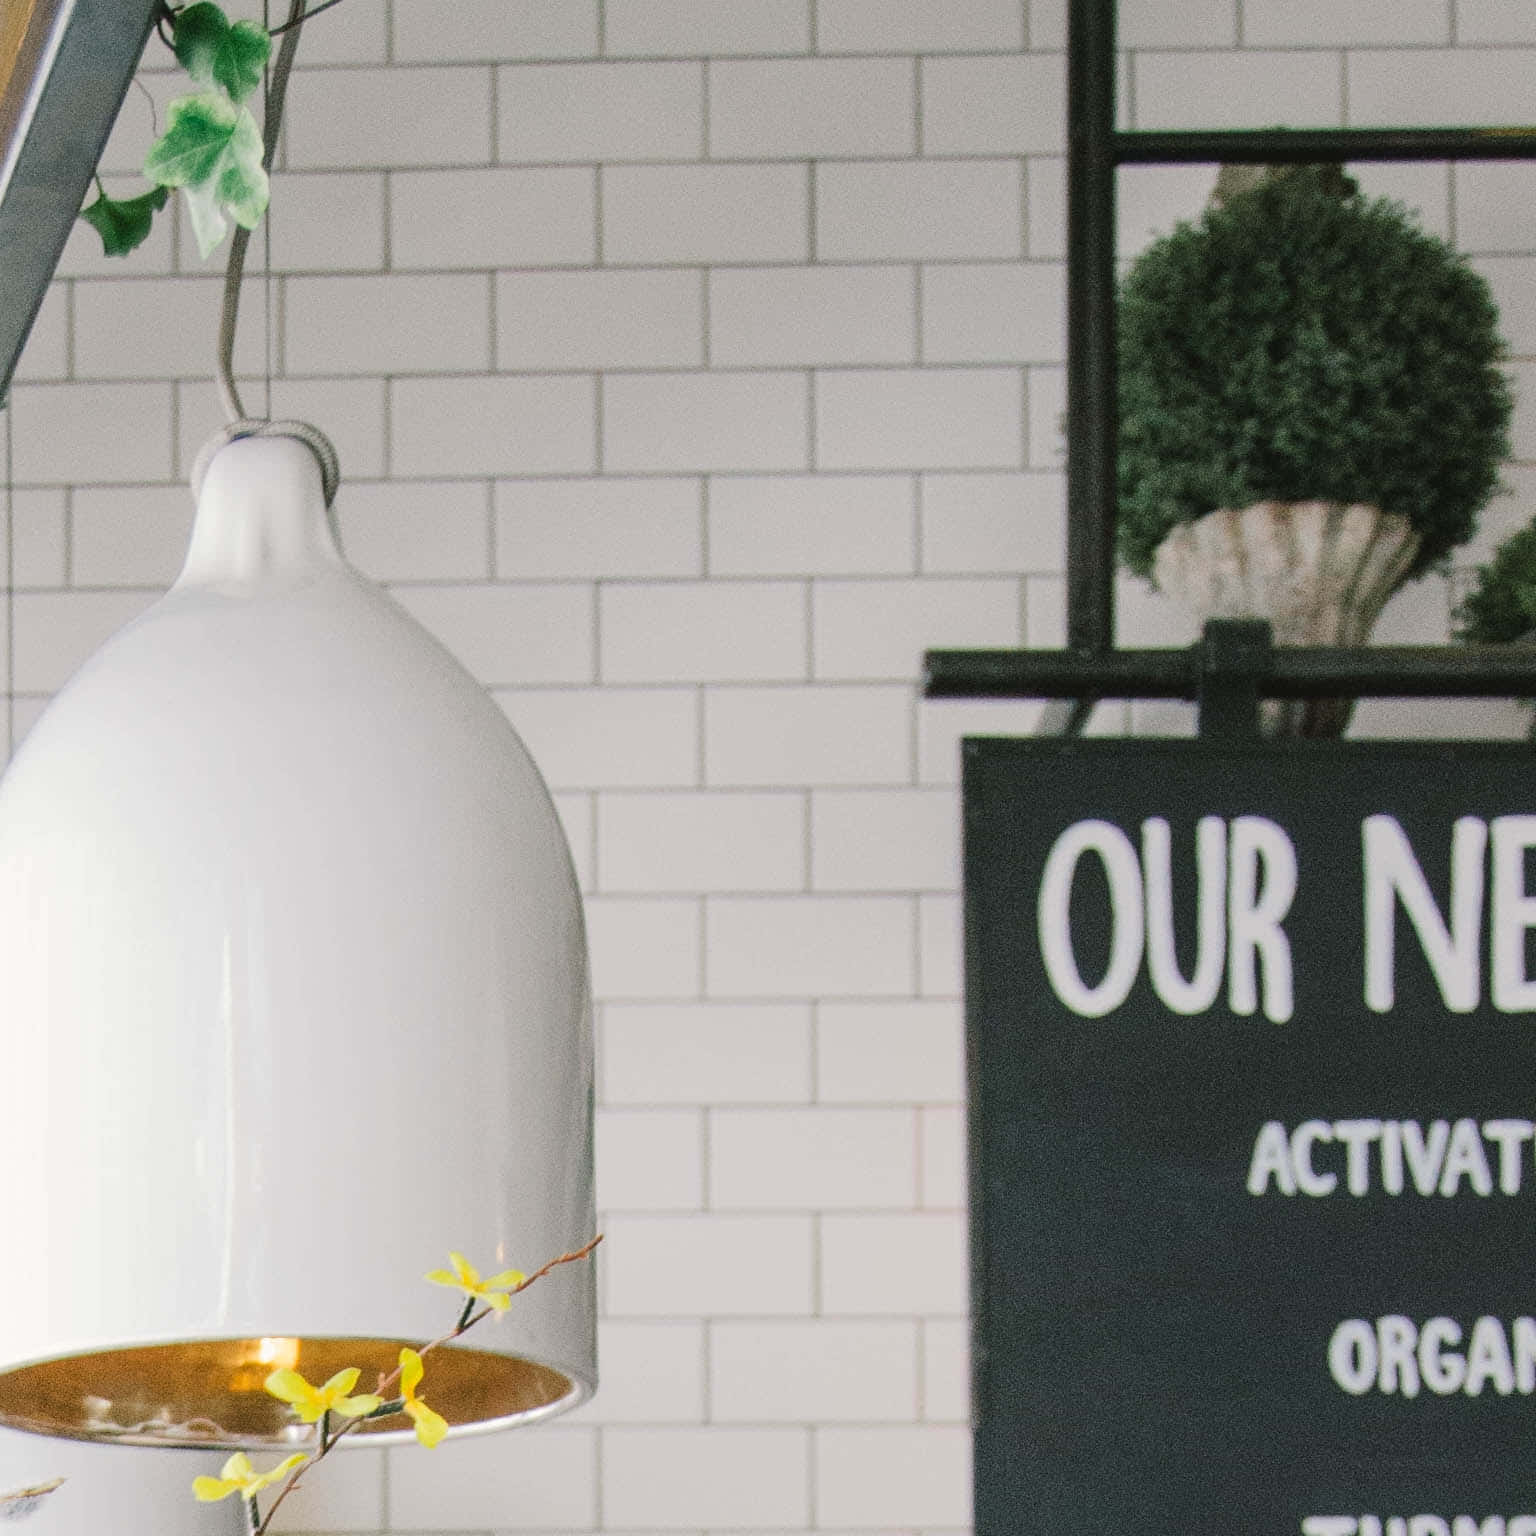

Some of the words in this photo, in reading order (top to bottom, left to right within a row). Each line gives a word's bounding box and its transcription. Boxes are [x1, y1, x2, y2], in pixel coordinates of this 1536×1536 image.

[1037, 815, 1298, 1025] OUR
[1361, 814, 1536, 1014] NE
[1246, 1117, 1536, 1198] ACTIVAT
